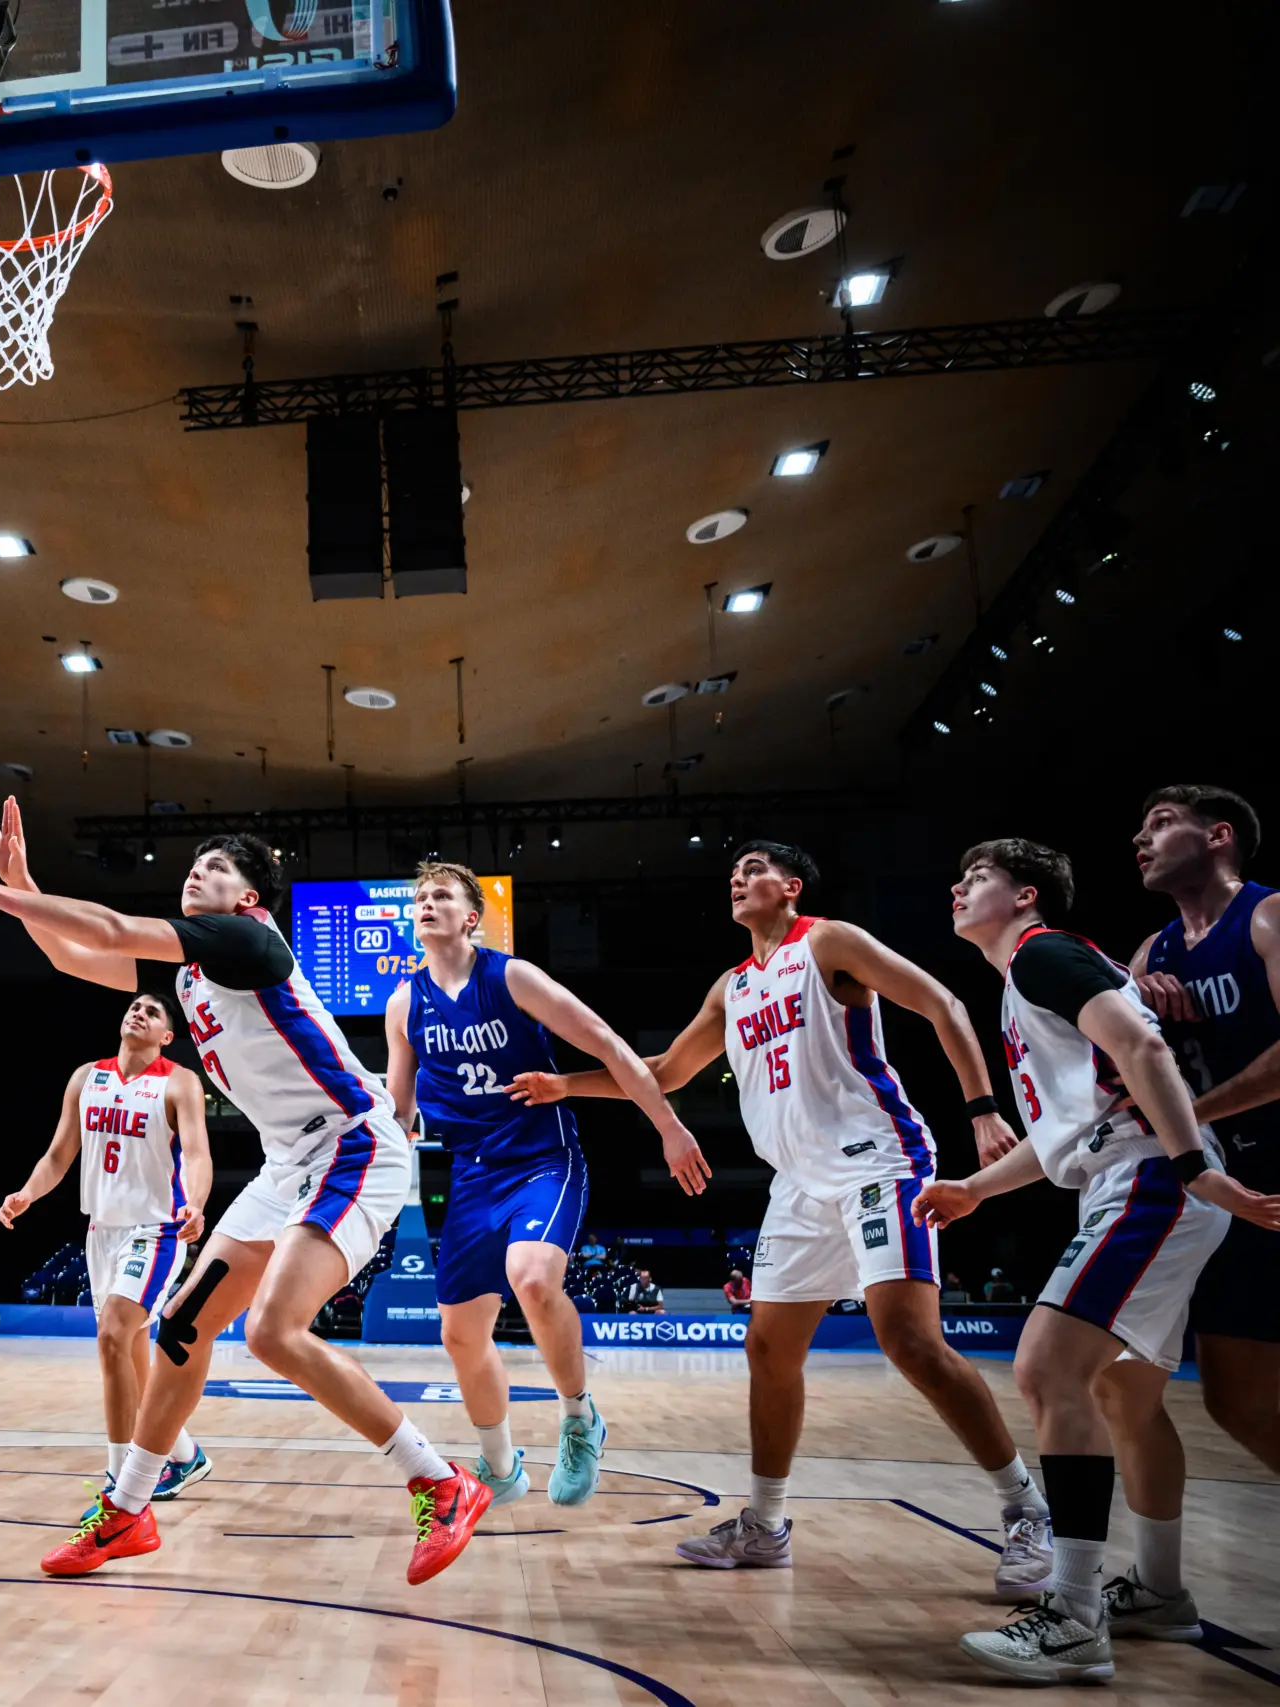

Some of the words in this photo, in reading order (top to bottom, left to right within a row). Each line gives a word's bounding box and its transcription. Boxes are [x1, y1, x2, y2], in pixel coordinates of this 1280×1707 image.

[360, 930, 384, 949] 20
[777, 961, 806, 978] FISU
[736, 992, 806, 1051] CHILE
[456, 1062, 505, 1096] 22
[766, 1044, 792, 1095] 15
[134, 1090, 159, 1099] FISU
[85, 1106, 149, 1139] CHILE
[103, 1140, 121, 1174] 6
[863, 1226, 885, 1241] UVM
[125, 1264, 142, 1273] UVM
[591, 1321, 655, 1341] WEST
[676, 1322, 747, 1341] LOTTO
